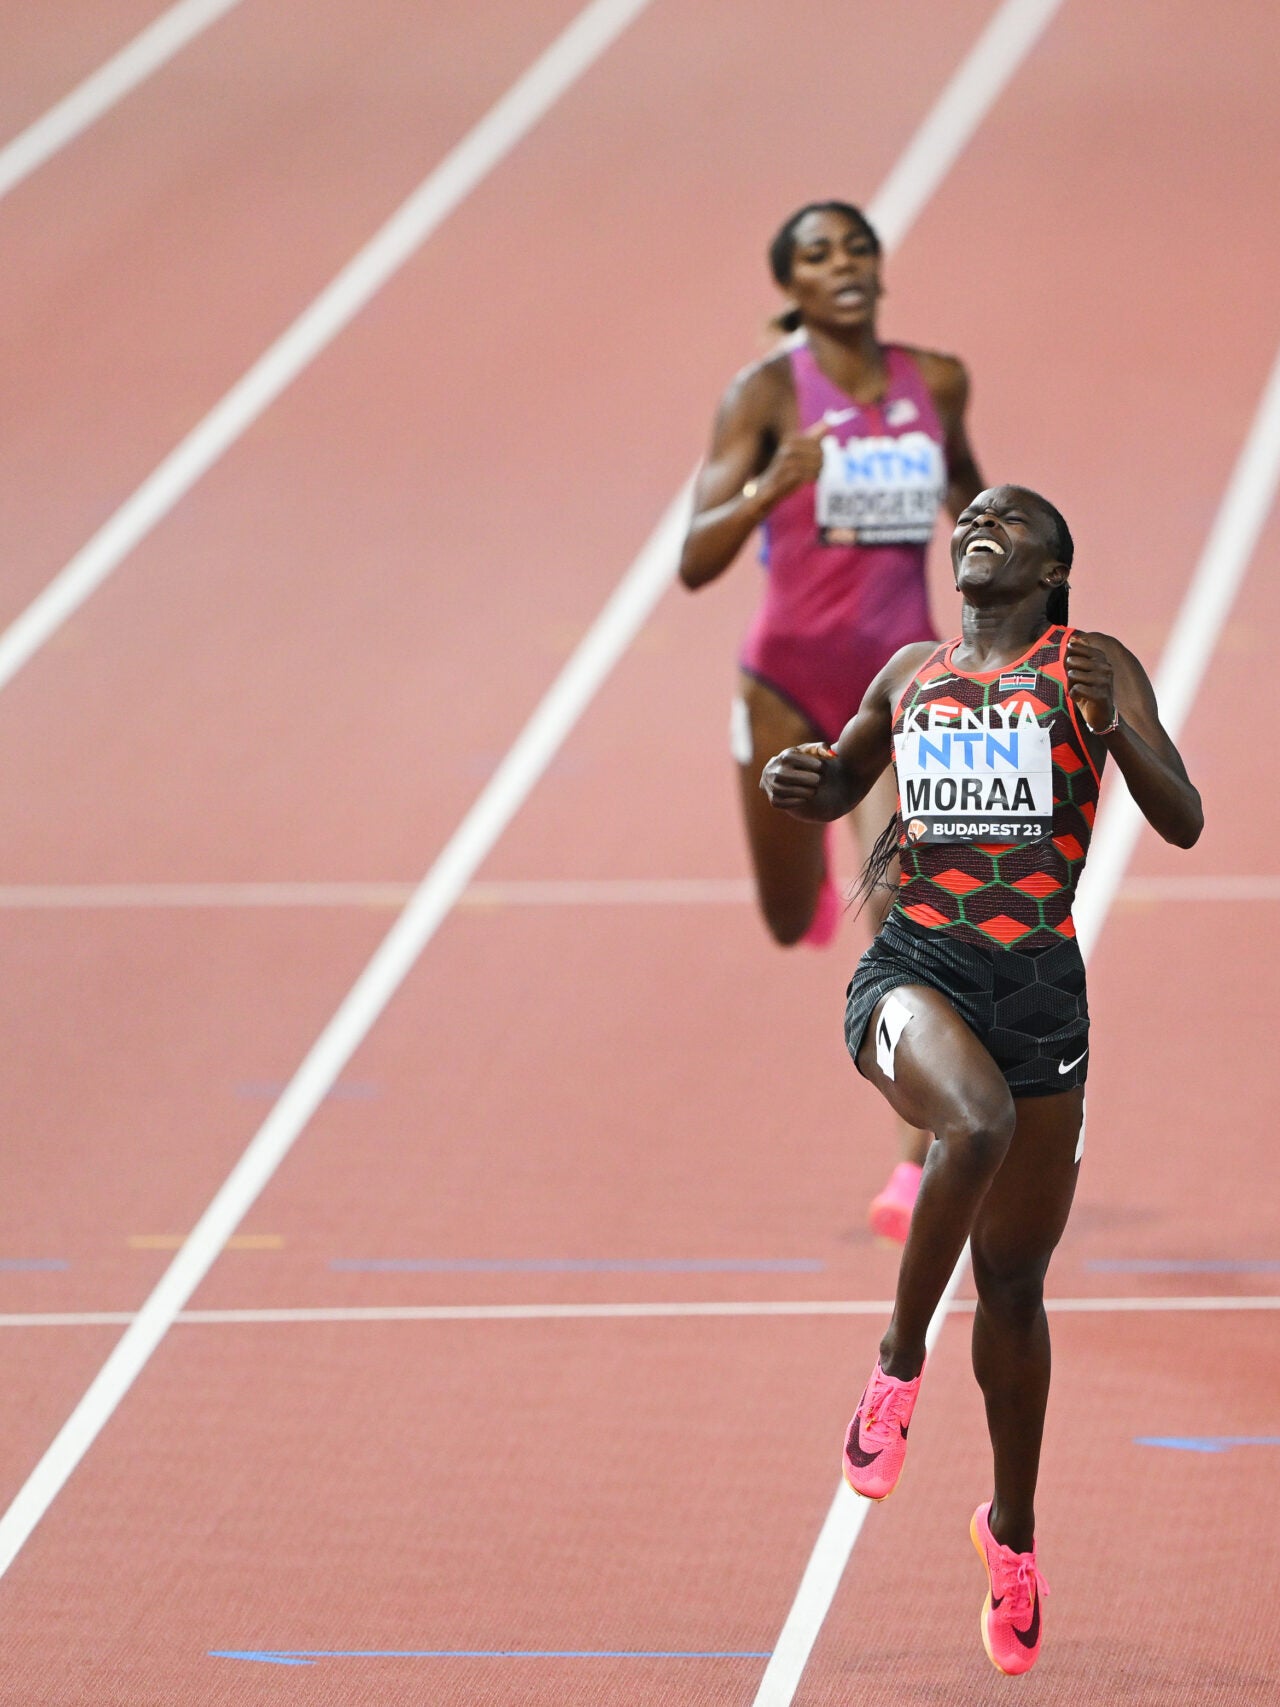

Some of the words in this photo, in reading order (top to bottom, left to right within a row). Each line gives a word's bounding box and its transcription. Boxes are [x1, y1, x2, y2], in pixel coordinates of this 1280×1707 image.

[846, 453, 930, 481] NTN
[903, 700, 1041, 734] KENYA
[918, 732, 1018, 770] NTN
[906, 777, 1036, 814] MORAA
[932, 823, 1021, 836] BUDAPEST
[1022, 824, 1042, 836] 23
